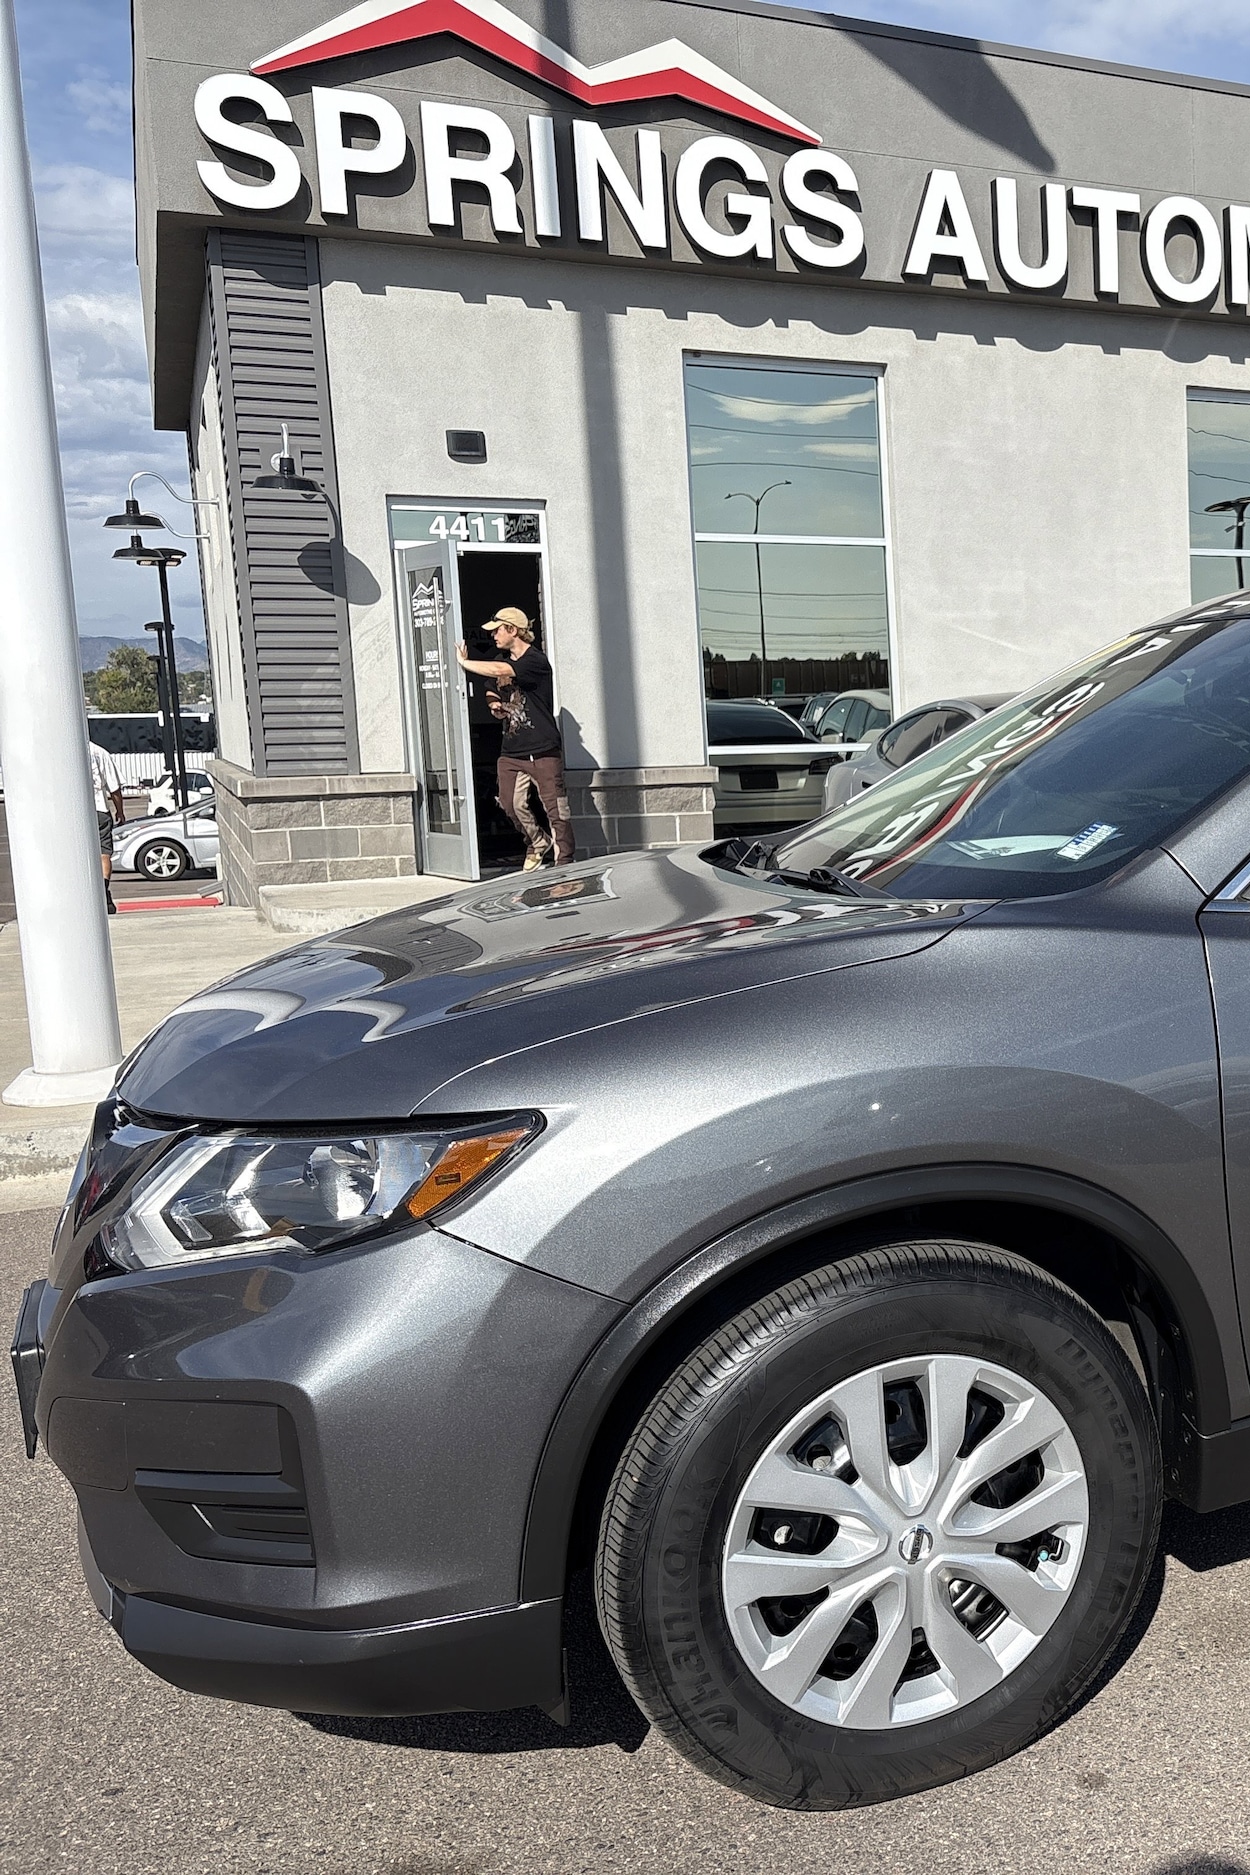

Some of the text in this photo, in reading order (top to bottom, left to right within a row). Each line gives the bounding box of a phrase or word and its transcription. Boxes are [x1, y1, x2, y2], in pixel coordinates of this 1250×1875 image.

[193, 72, 865, 269] SPRINGS
[428, 515, 507, 542] 4411
[412, 596, 444, 612] SPRINS
